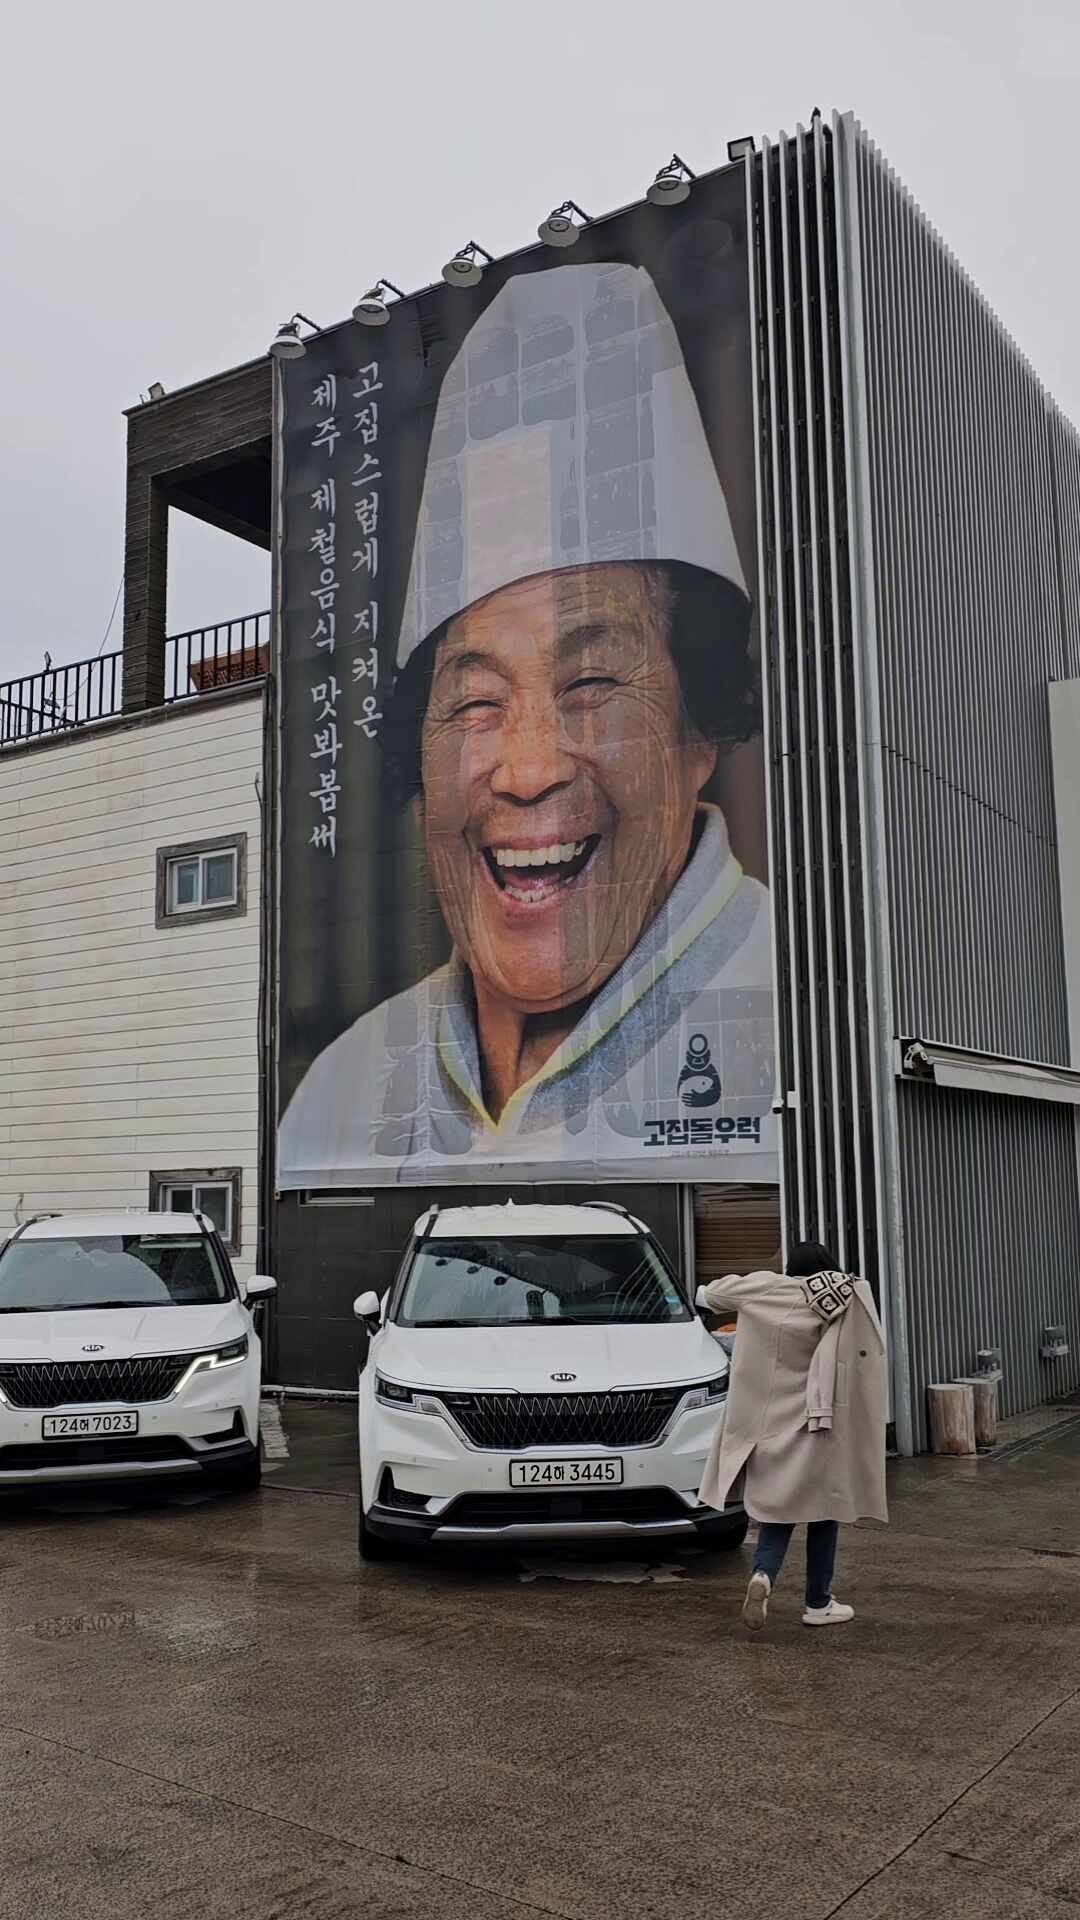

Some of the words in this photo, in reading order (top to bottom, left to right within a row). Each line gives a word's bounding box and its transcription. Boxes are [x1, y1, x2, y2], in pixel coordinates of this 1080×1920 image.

[310, 374, 342, 457] 제주
[351, 361, 384, 578] 고집스럽게
[308, 478, 340, 654] 제철음식
[351, 600, 383, 738] 지켜온
[643, 1116, 760, 1147] 고집돌우럭
[83, 1344, 103, 1352] KIA
[552, 1373, 576, 1381] KIA
